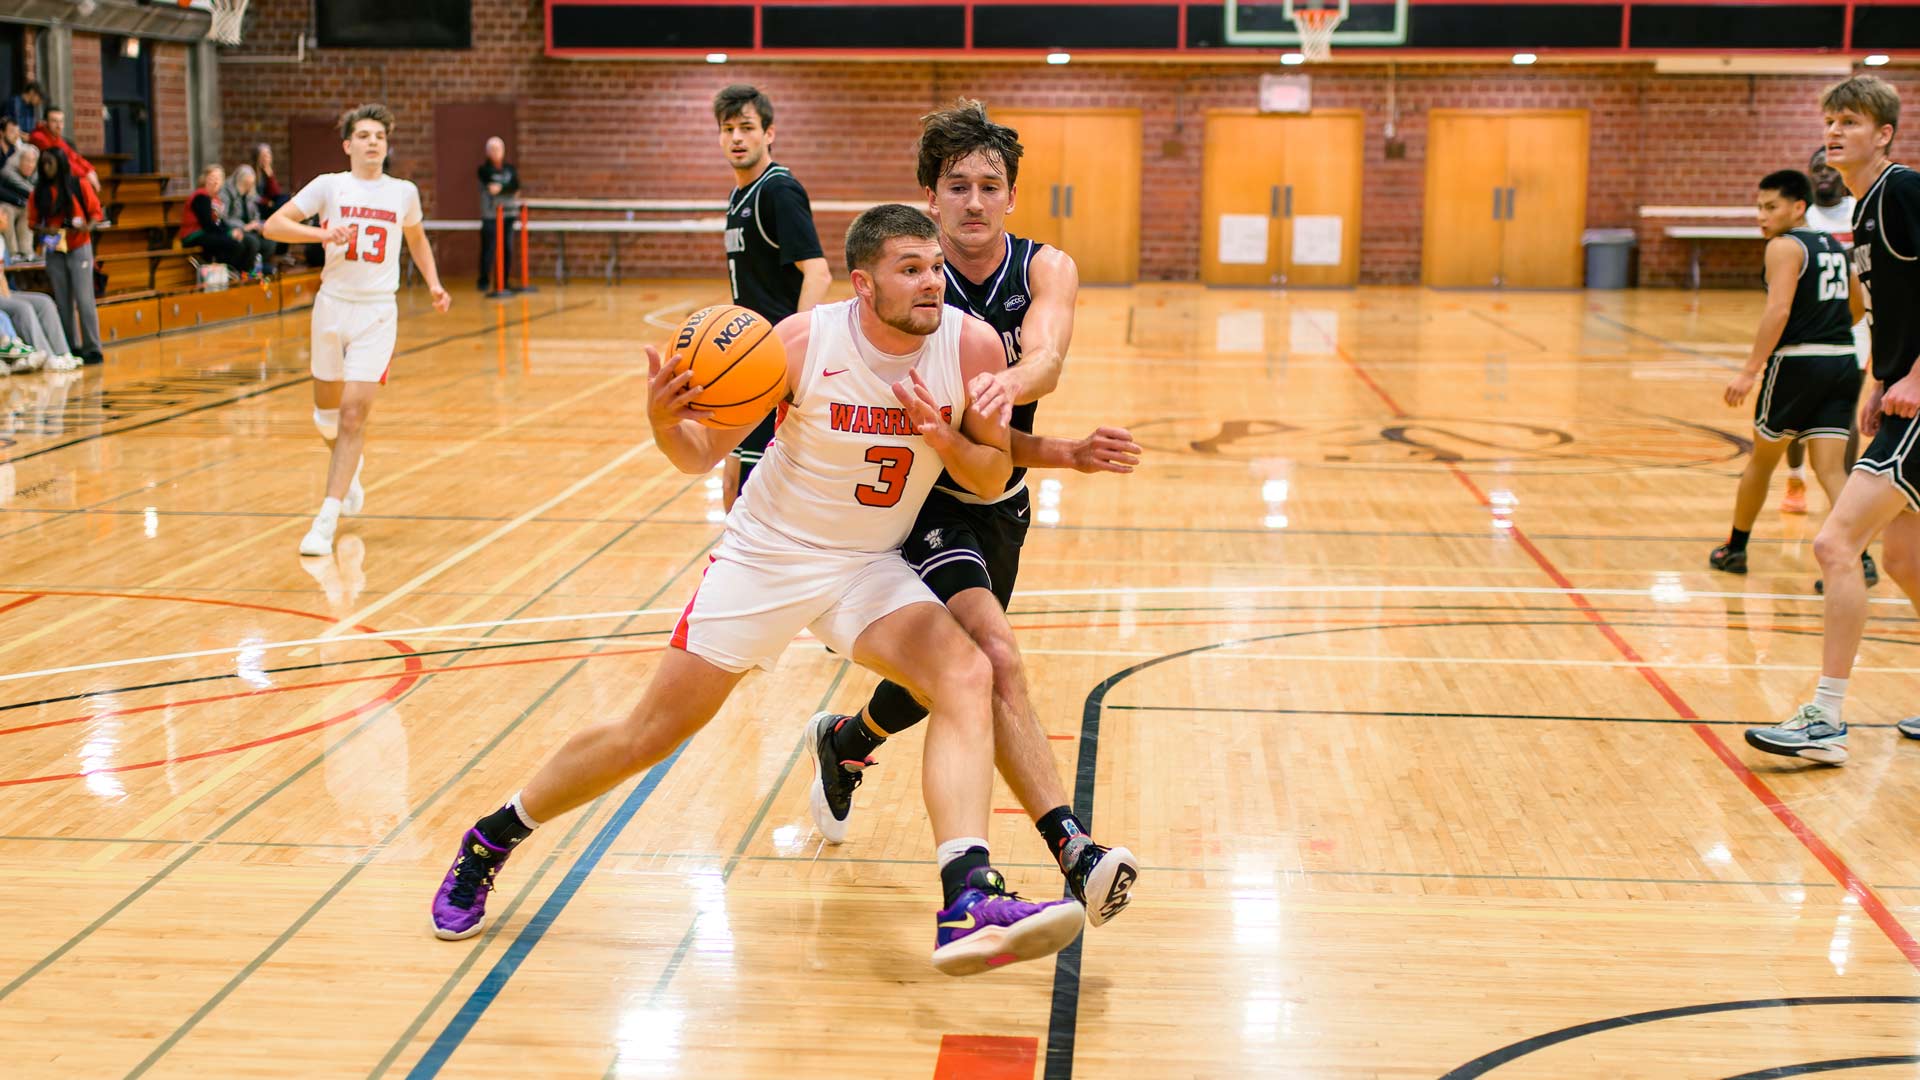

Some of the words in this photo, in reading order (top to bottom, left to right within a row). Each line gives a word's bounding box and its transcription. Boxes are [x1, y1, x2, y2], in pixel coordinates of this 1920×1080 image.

[345, 223, 387, 264] 13
[1817, 252, 1849, 301] 23
[713, 312, 758, 352] NCAA
[830, 402, 952, 436] WARRIS
[854, 445, 915, 509] 3
